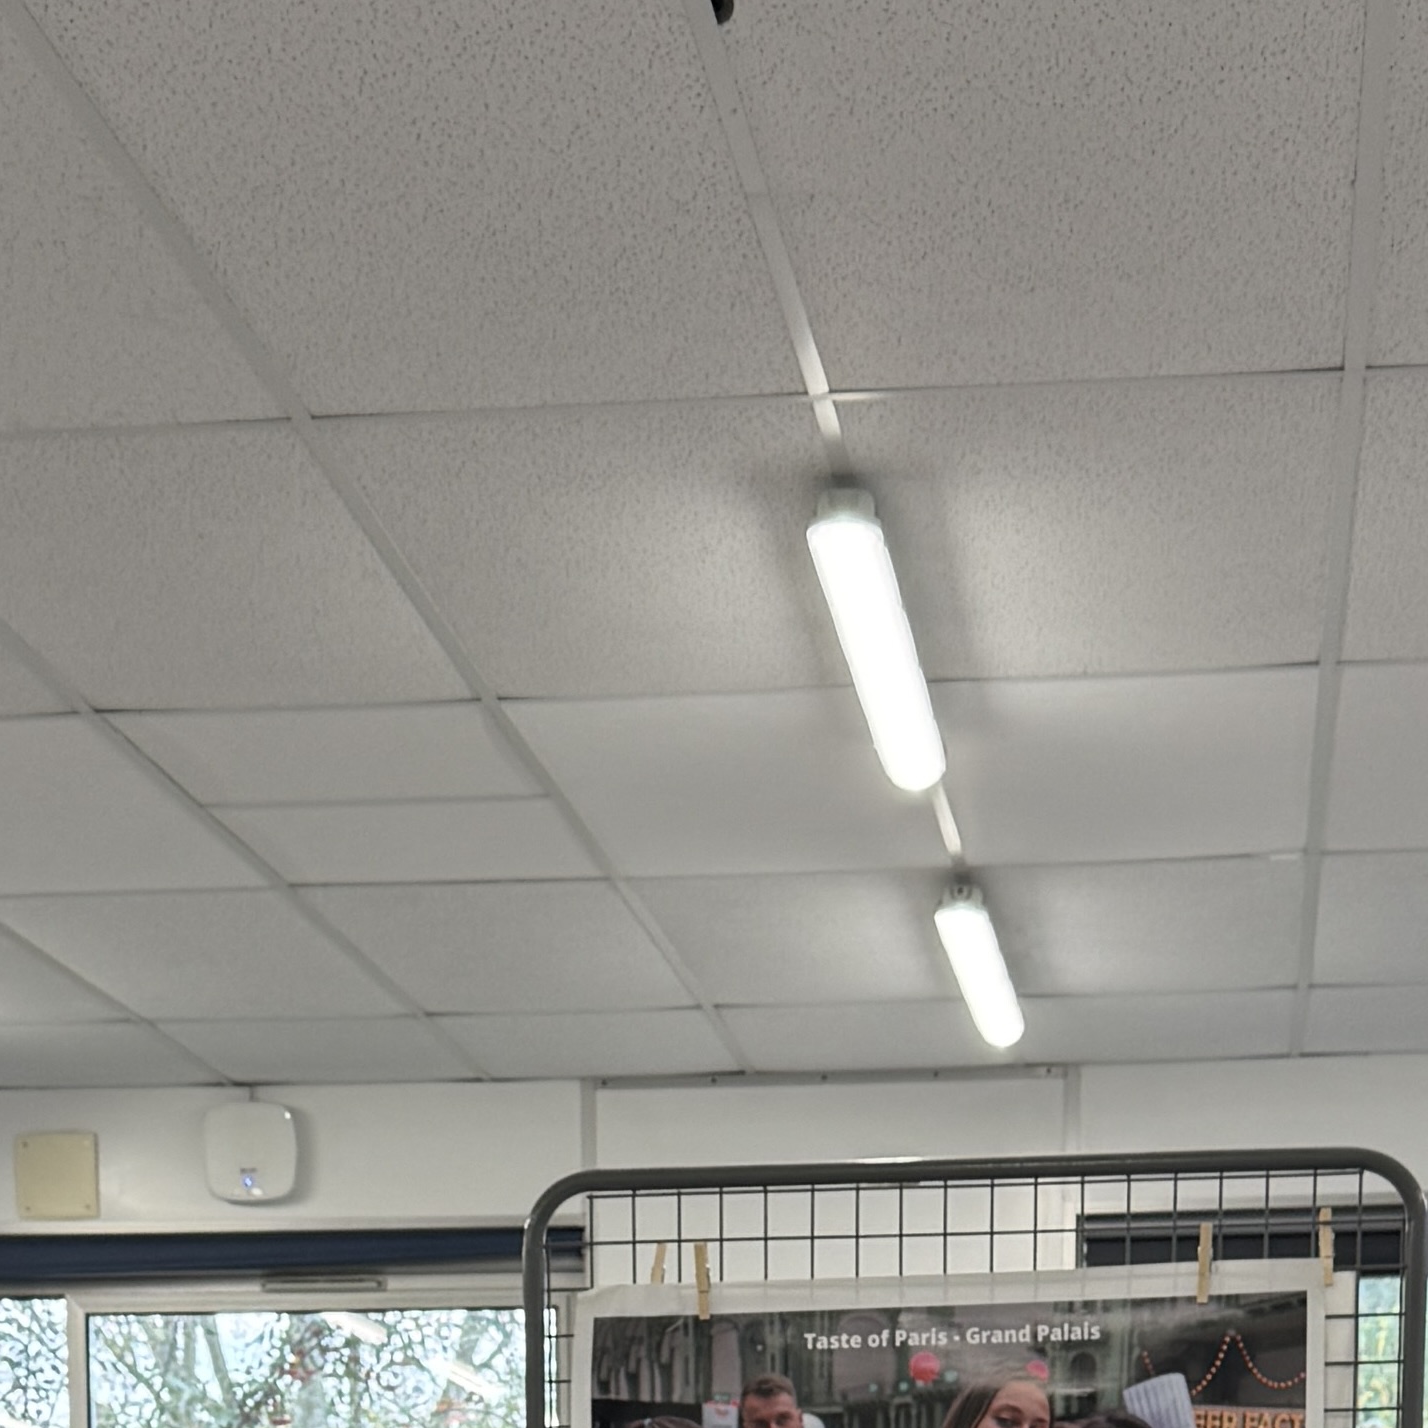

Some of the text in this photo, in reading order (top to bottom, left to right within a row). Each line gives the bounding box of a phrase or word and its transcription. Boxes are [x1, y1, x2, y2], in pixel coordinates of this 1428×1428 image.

[804, 1333, 862, 1349] Taste
[868, 1330, 889, 1348] of
[895, 1328, 947, 1346] Paris
[966, 1325, 1030, 1344] Grand
[1036, 1322, 1101, 1342] Palais
